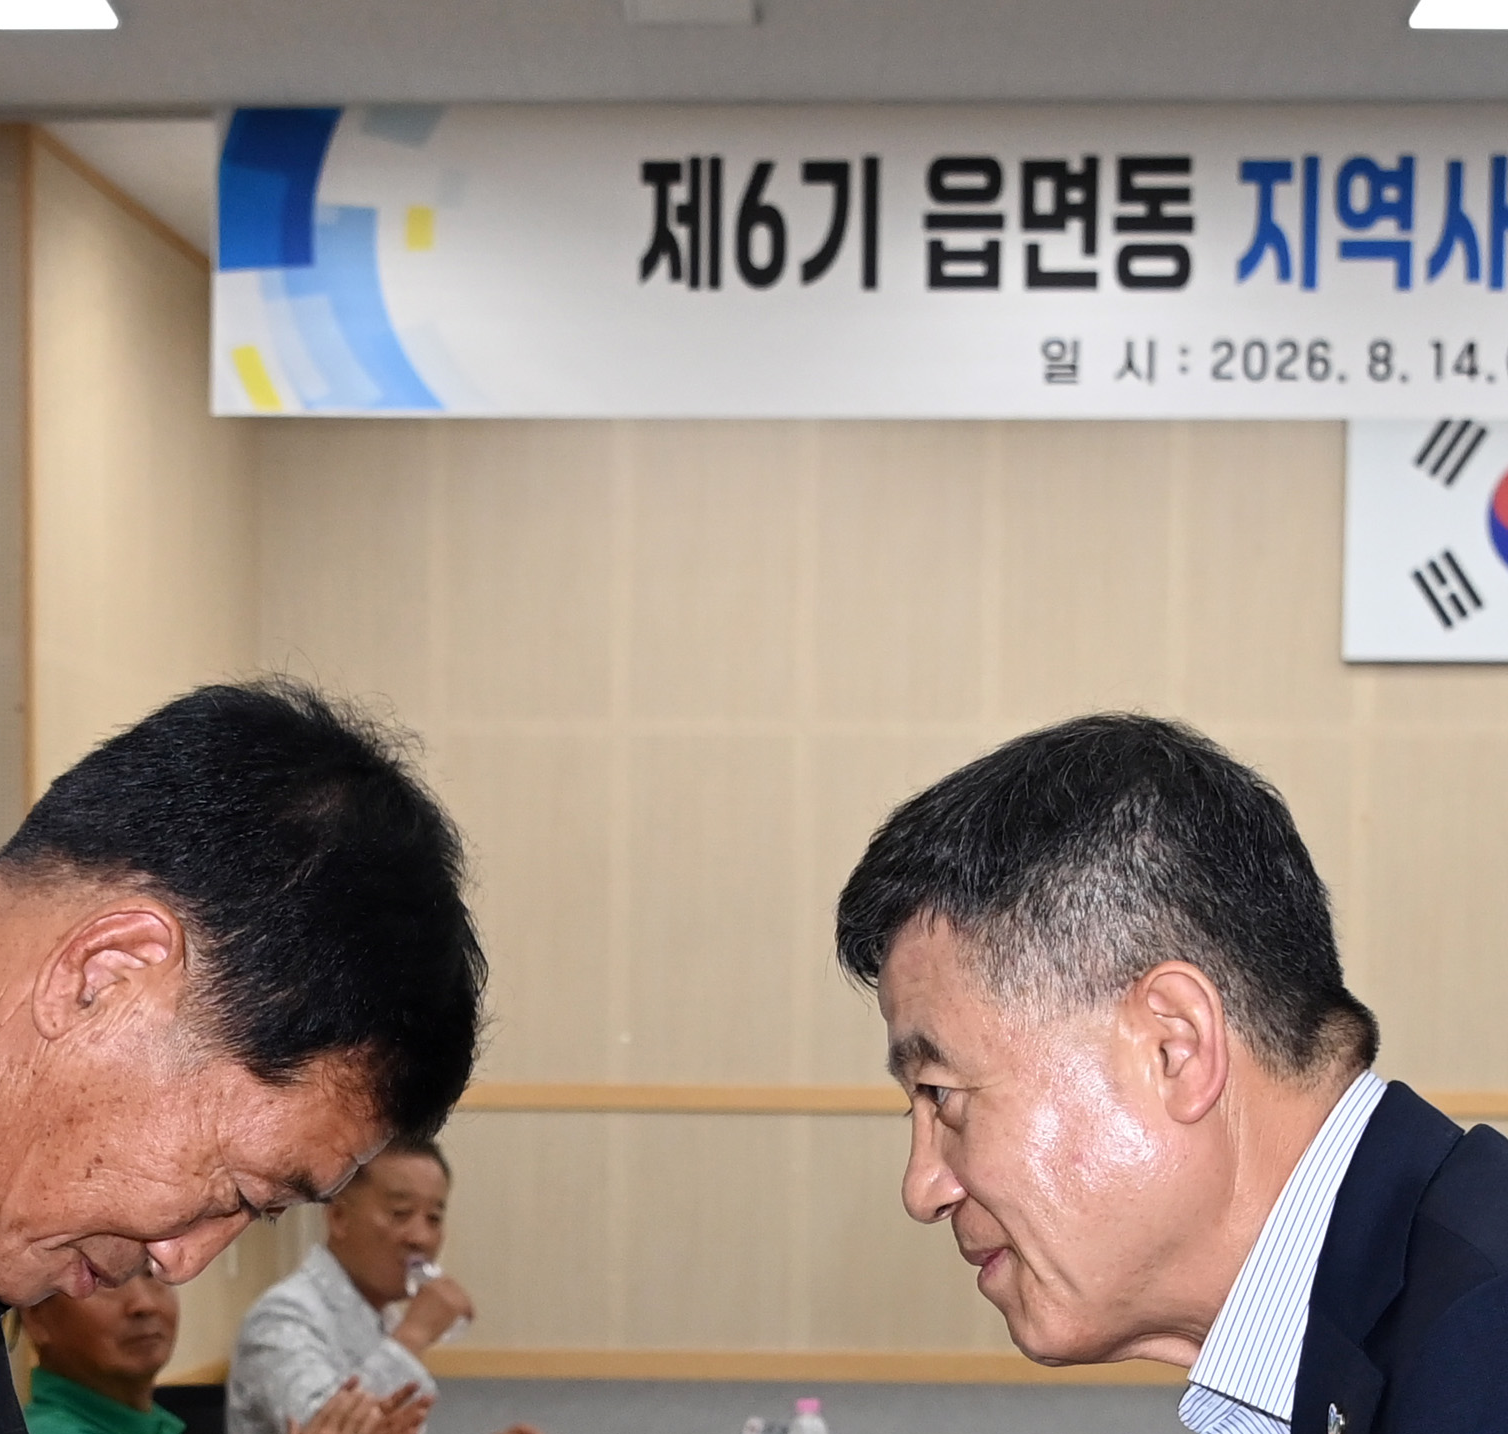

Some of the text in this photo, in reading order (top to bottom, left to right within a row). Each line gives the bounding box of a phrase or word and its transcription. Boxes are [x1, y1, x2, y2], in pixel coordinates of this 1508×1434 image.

[637, 152, 884, 291] 제6기
[922, 152, 1196, 291] 읍면동
[1210, 340, 1346, 383] 2026.
[1367, 340, 1407, 383] 8.
